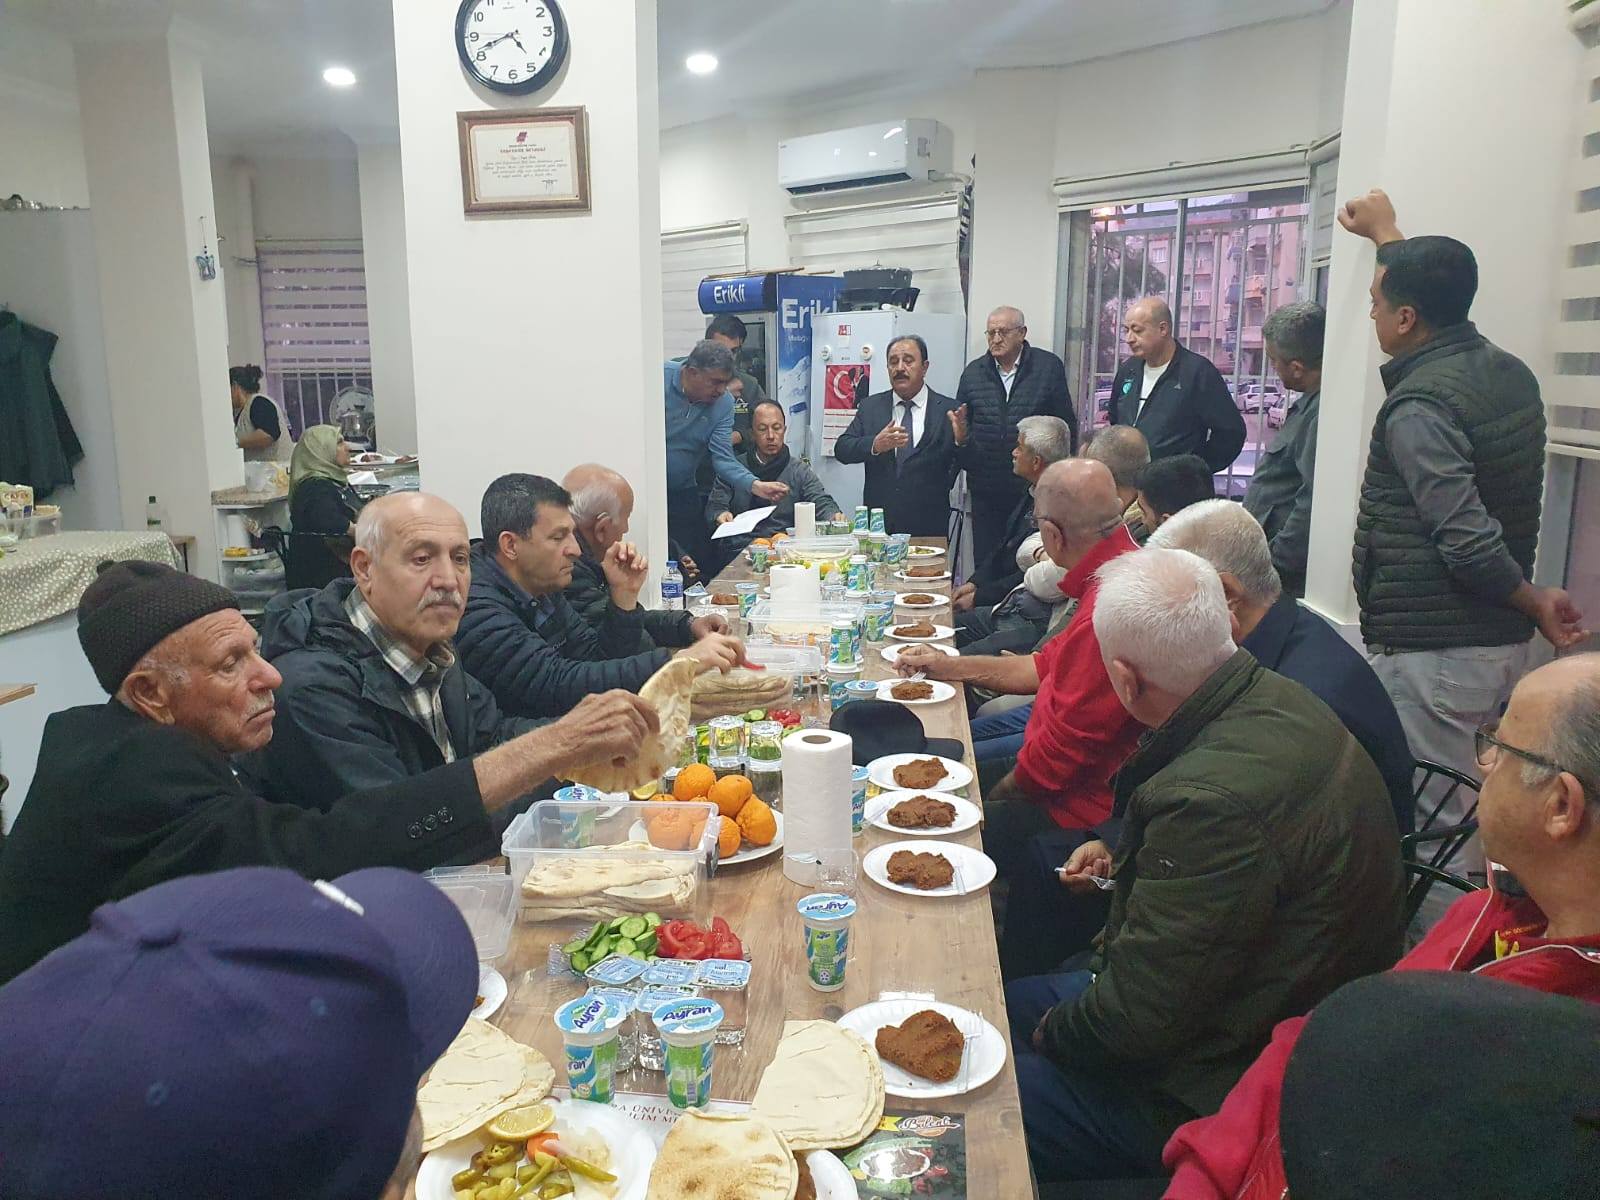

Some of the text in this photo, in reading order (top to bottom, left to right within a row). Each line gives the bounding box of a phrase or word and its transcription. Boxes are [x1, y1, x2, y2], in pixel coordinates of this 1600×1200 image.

[474, 11, 484, 22] 10
[536, 7, 545, 18] 2
[469, 31, 479, 42] 9
[543, 26, 552, 37] 3
[476, 50, 487, 61] 8
[490, 65, 499, 75] 7
[526, 62, 536, 73] 5
[508, 69, 518, 79] 6
[713, 283, 745, 304] Erikli
[806, 900, 849, 911] Ayran
[573, 999, 604, 1029] Ayran
[662, 1005, 712, 1022] Ayran
